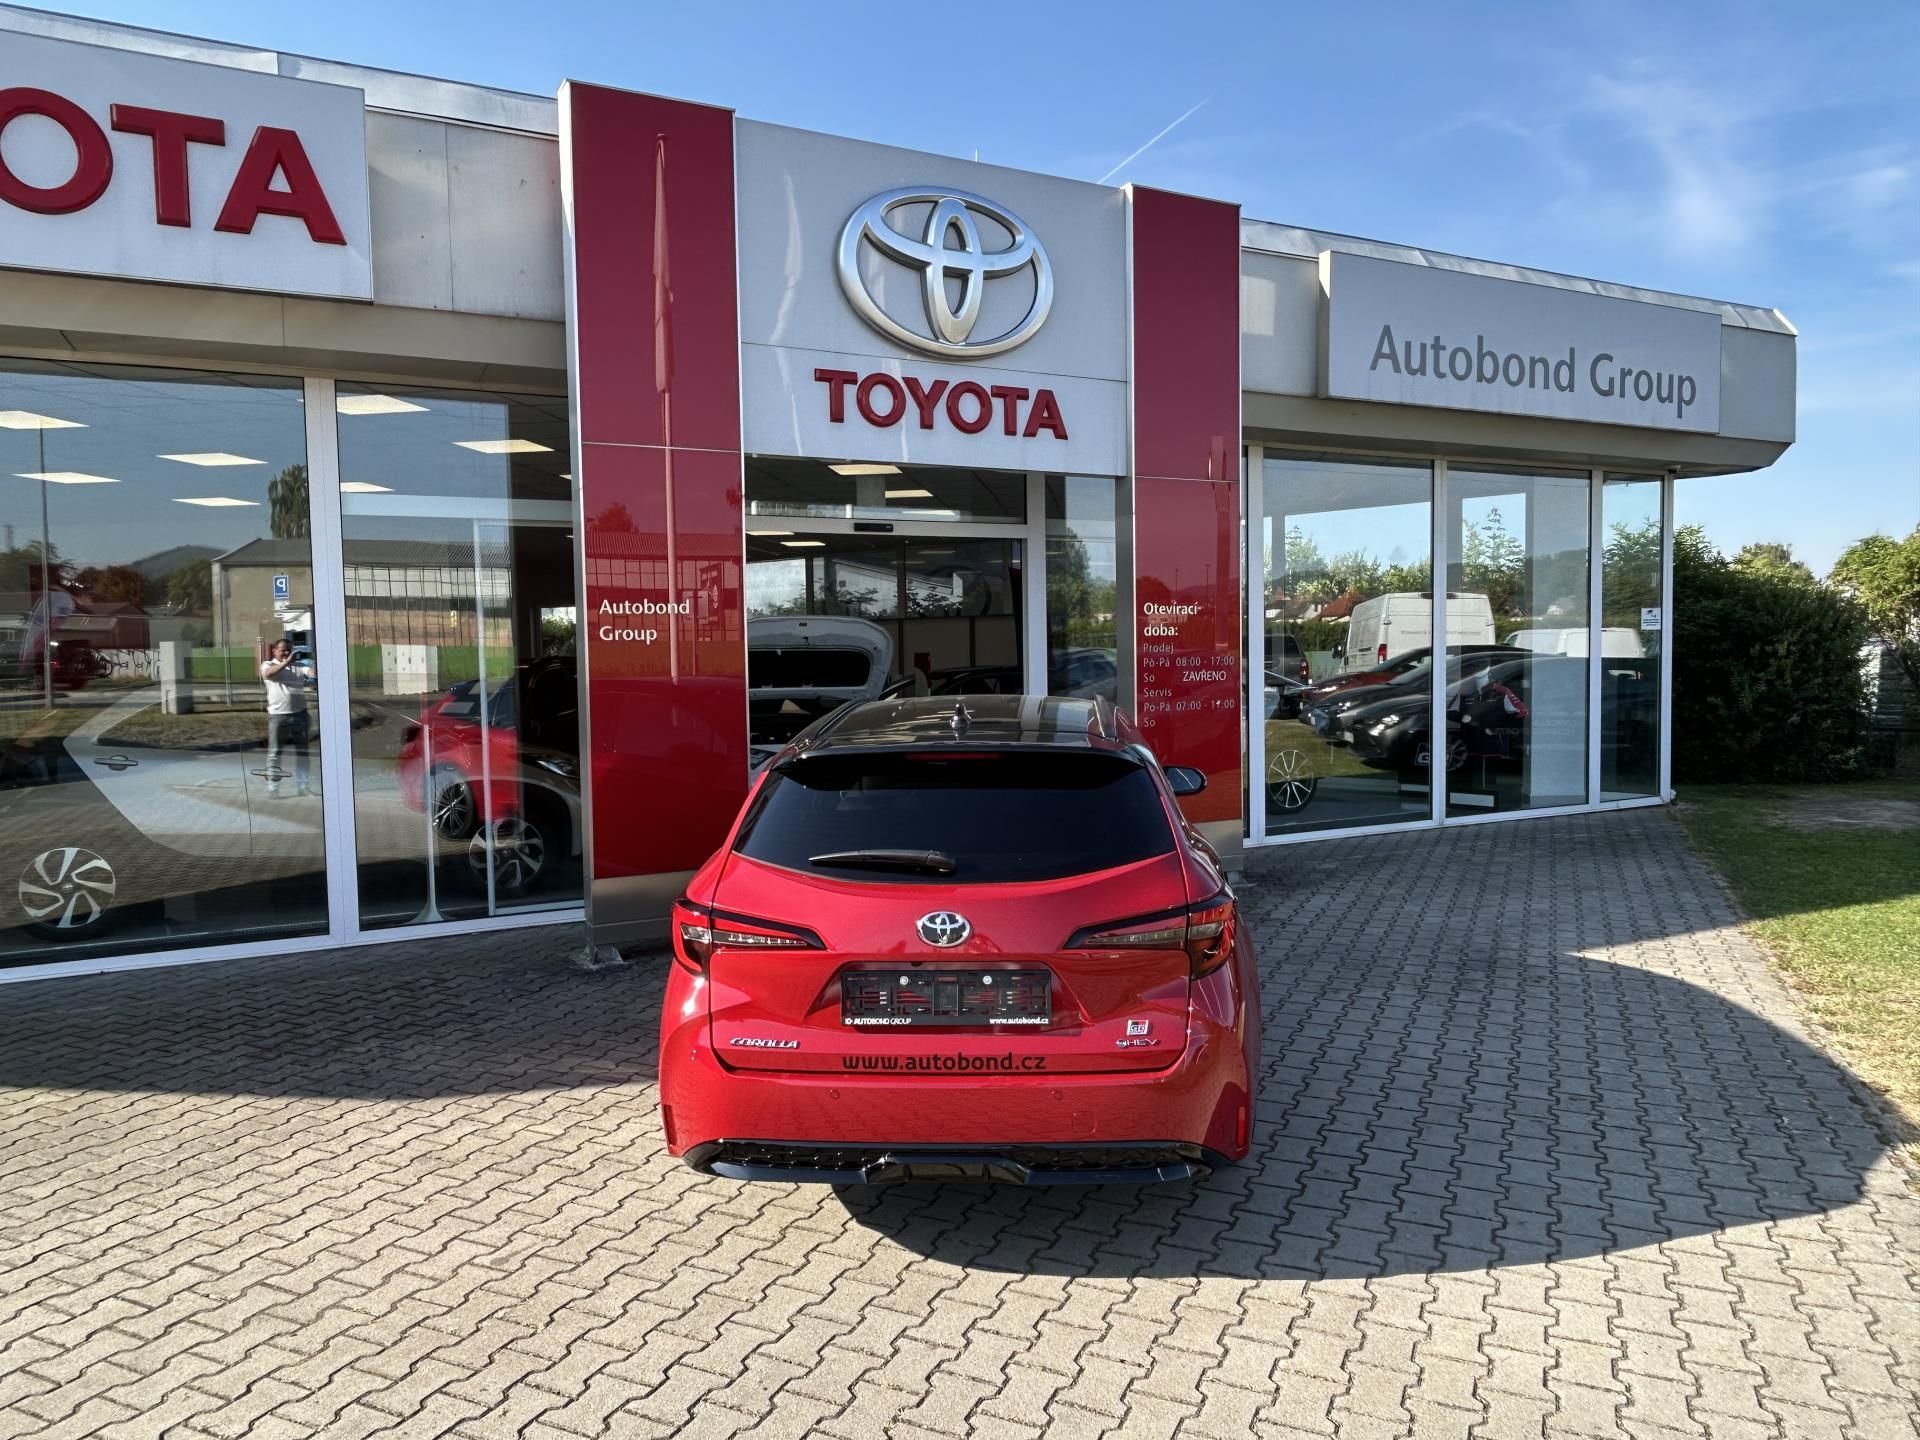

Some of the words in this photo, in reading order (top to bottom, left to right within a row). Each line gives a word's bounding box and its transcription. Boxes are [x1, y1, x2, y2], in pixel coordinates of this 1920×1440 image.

[1369, 324, 1576, 393] Autobond
[1589, 353, 1697, 419] Group
[814, 368, 1069, 440] TOYOTA
[599, 598, 690, 614] Autobond
[1143, 601, 1198, 615] Otevírací
[599, 625, 658, 645] Group
[1143, 623, 1179, 637] doba:
[1143, 642, 1174, 655] Prodej
[1175, 657, 1201, 667] 08:00
[1210, 655, 1235, 666] 17:00
[1143, 672, 1155, 683] So
[1182, 669, 1227, 682] ZAVŘENO
[1143, 687, 1172, 698] Servis
[1176, 701, 1202, 711] 07:00
[1211, 699, 1235, 710] 17:00
[1143, 717, 1156, 728] So
[853, 1017, 889, 1025] AUTOBOND
[890, 1017, 912, 1025] GROUP
[989, 1016, 1049, 1025] www.autobond.cz
[730, 1037, 799, 1049] COROLLA
[842, 1052, 1047, 1071] www.autobond.cz
